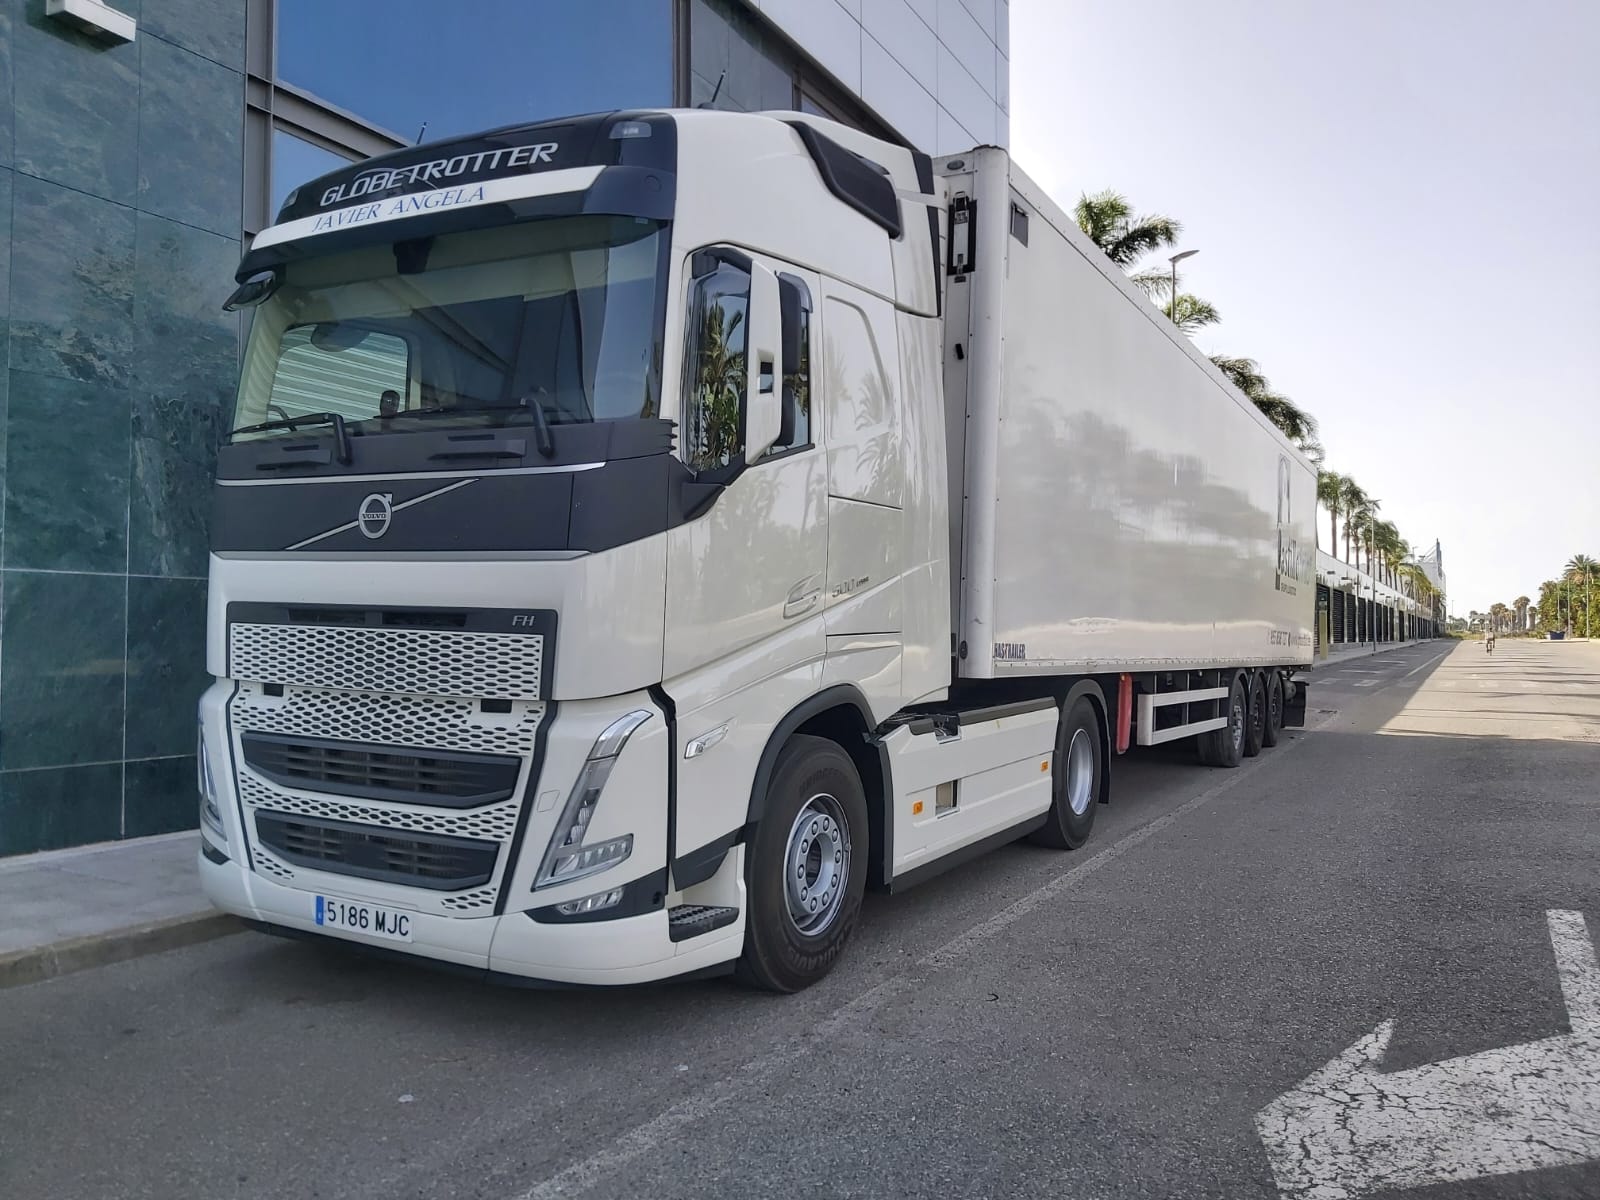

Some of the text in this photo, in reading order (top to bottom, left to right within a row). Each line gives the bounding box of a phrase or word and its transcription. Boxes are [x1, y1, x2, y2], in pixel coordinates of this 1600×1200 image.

[319, 142, 558, 207] GLOBETROTTER
[311, 184, 485, 232] JAVIER ANGELA
[512, 615, 535, 626] FH
[327, 901, 409, 936] 5186 MJC
